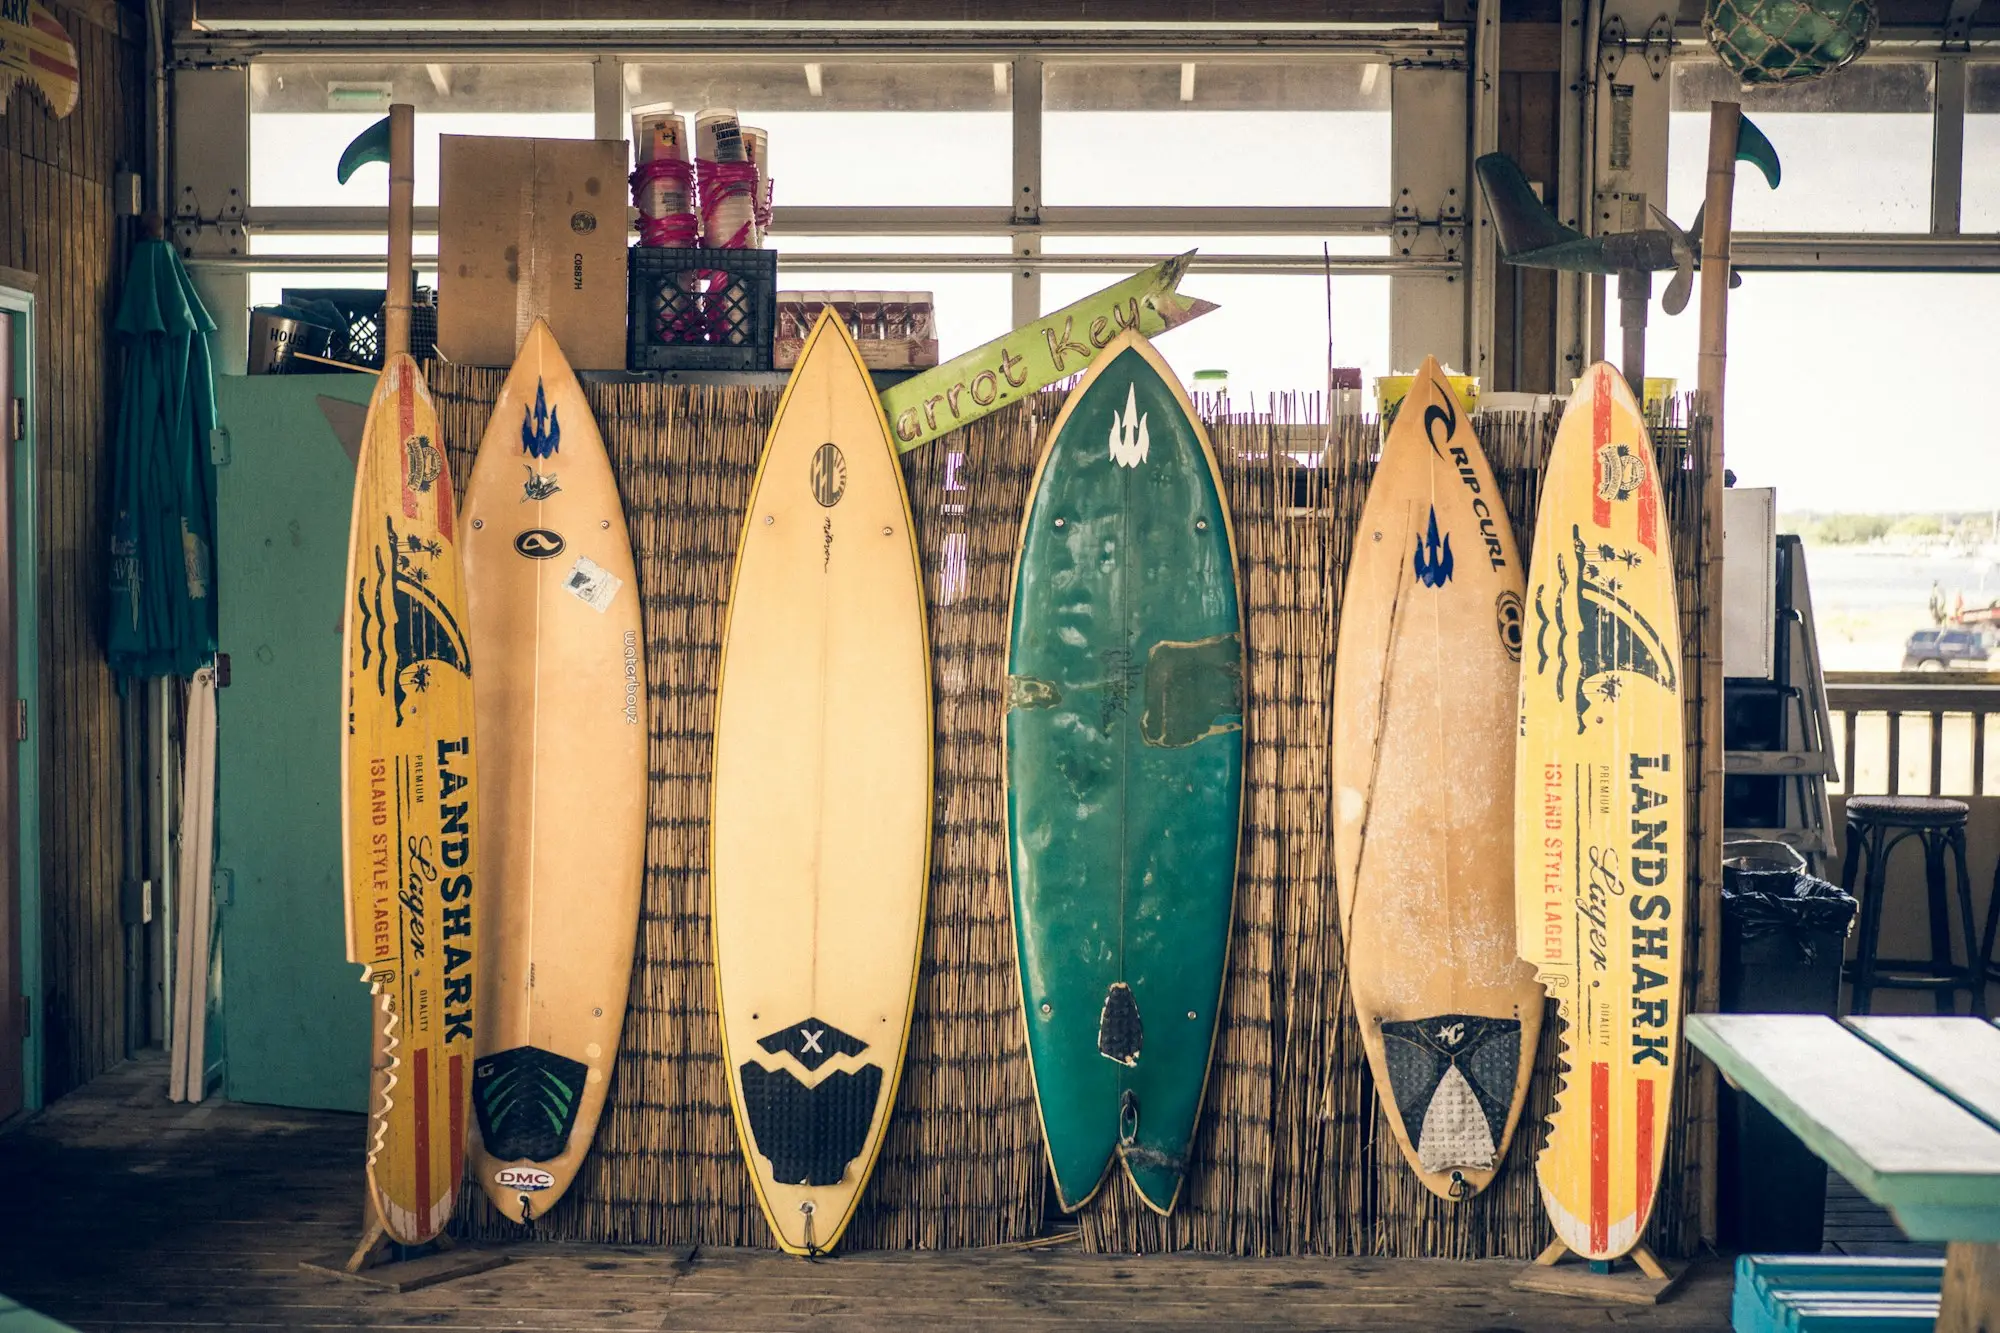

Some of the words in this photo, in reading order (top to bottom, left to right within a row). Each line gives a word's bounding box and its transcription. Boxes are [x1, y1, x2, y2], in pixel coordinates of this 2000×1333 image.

[1046, 297, 1141, 372] Key
[1450, 447, 1481, 494] RIP
[1473, 498, 1507, 573] CURL
[624, 630, 638, 724] waterboyz
[370, 758, 387, 826] ISLAND
[415, 754, 424, 804] PREMIUM
[1545, 763, 1562, 830] ISLAND
[1599, 765, 1610, 814] PREMIUM
[372, 833, 389, 890] STYLE
[437, 736, 473, 1044] LANDSHARK
[1545, 837, 1562, 894] STYLE
[373, 892, 390, 957] LAGER
[1545, 901, 1562, 960] LAGER
[1630, 753, 1671, 1067] LANDSHARK
[500, 1172, 550, 1184] DMC
